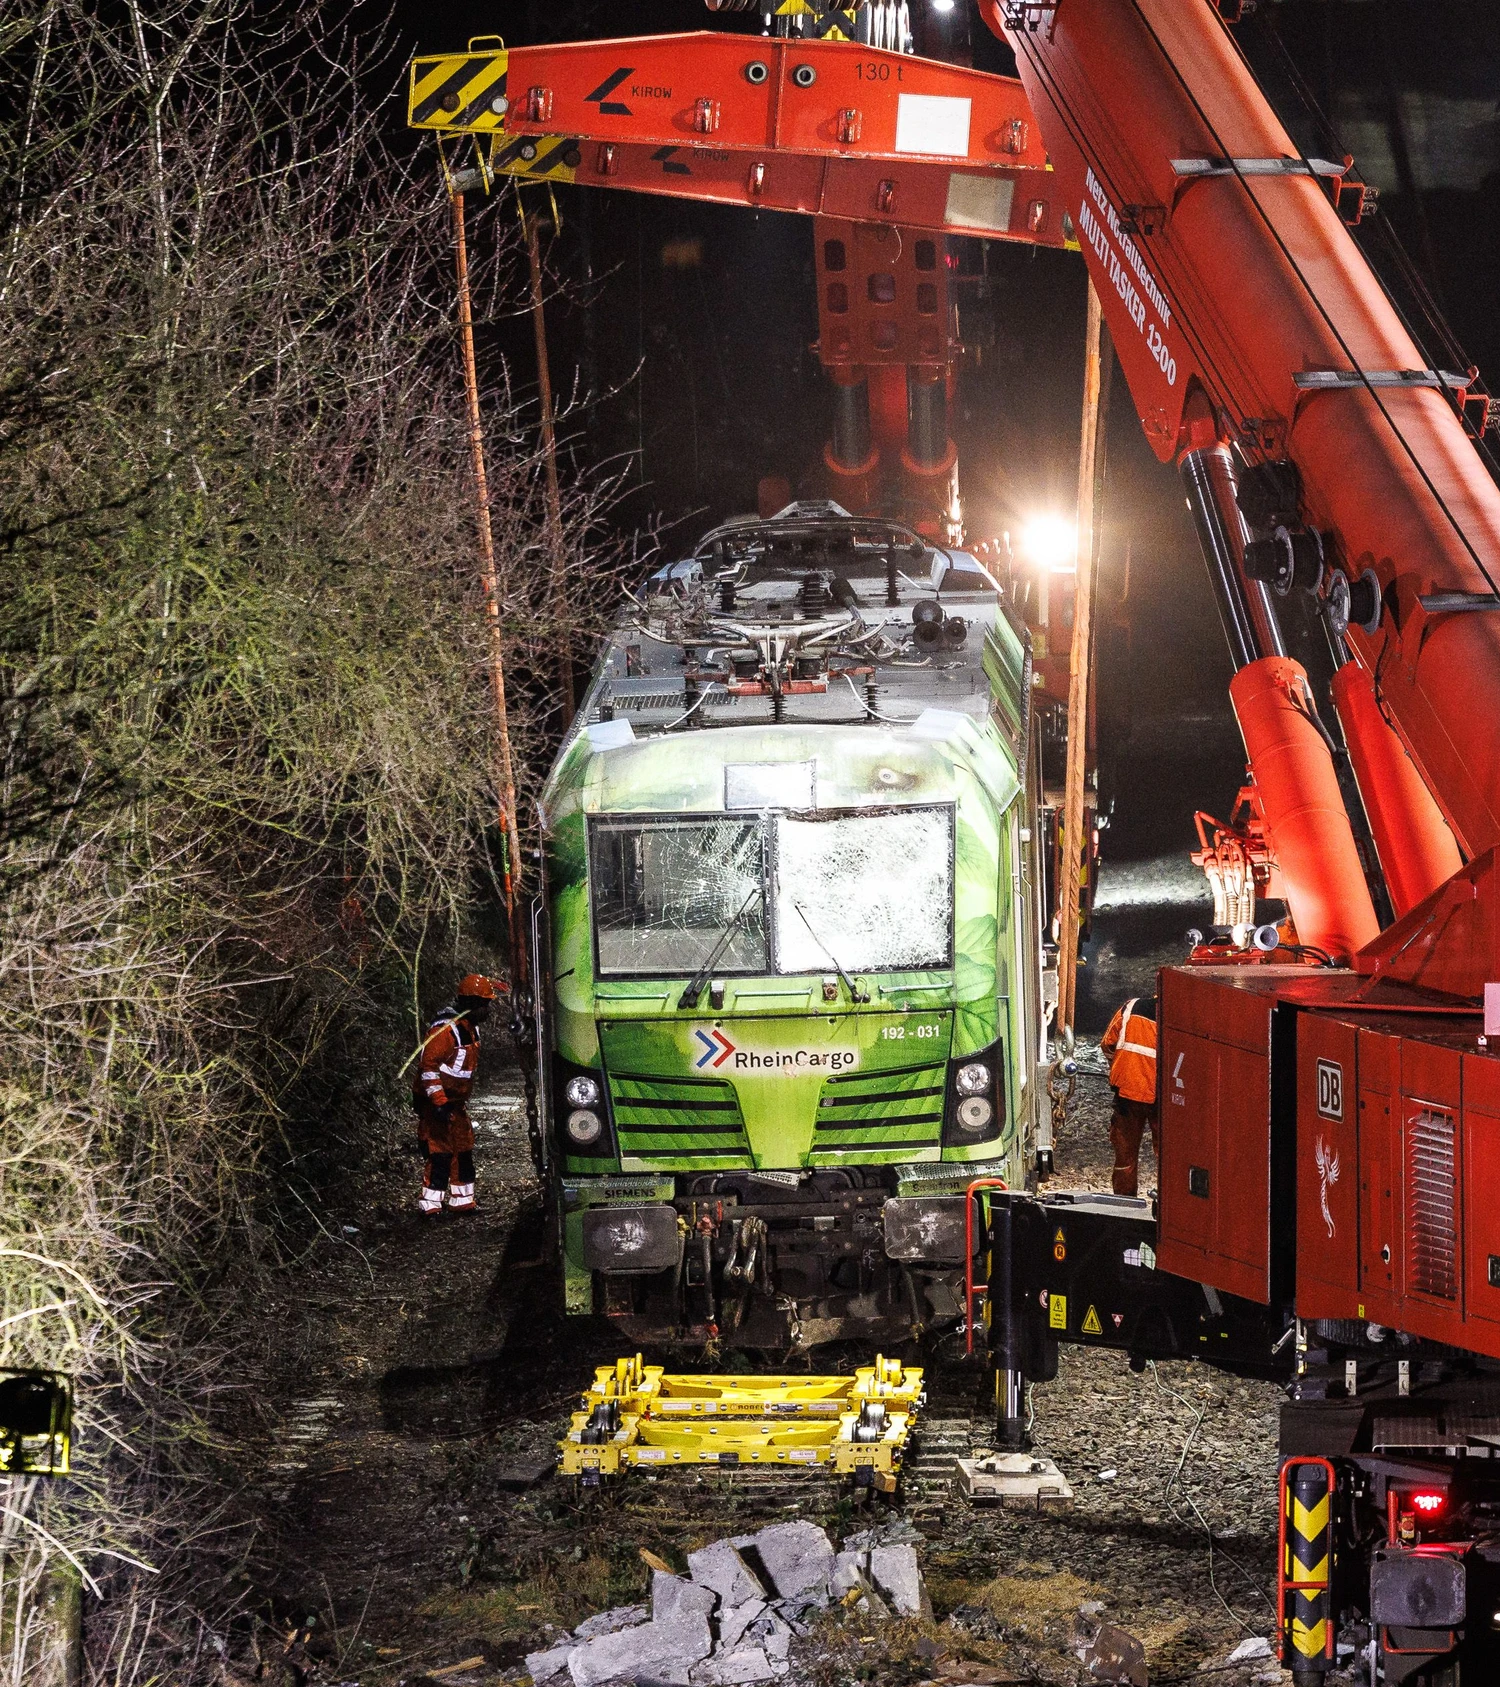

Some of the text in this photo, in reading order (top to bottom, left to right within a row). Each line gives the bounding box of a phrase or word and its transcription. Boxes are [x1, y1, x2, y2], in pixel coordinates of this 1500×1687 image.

[855, 62, 903, 81] 130 t
[631, 86, 673, 99] KIROW
[693, 148, 730, 162] KIROW
[1085, 165, 1108, 216] Netz
[1079, 199, 1177, 386] MULTI TASKER 1200
[881, 1026, 905, 1040] 192
[917, 1024, 941, 1039] 031
[735, 1050, 855, 1070] RheinCargo
[1320, 1068, 1341, 1112] DB
[604, 1187, 656, 1199] SIEMENS
[912, 1181, 960, 1193] Stron
